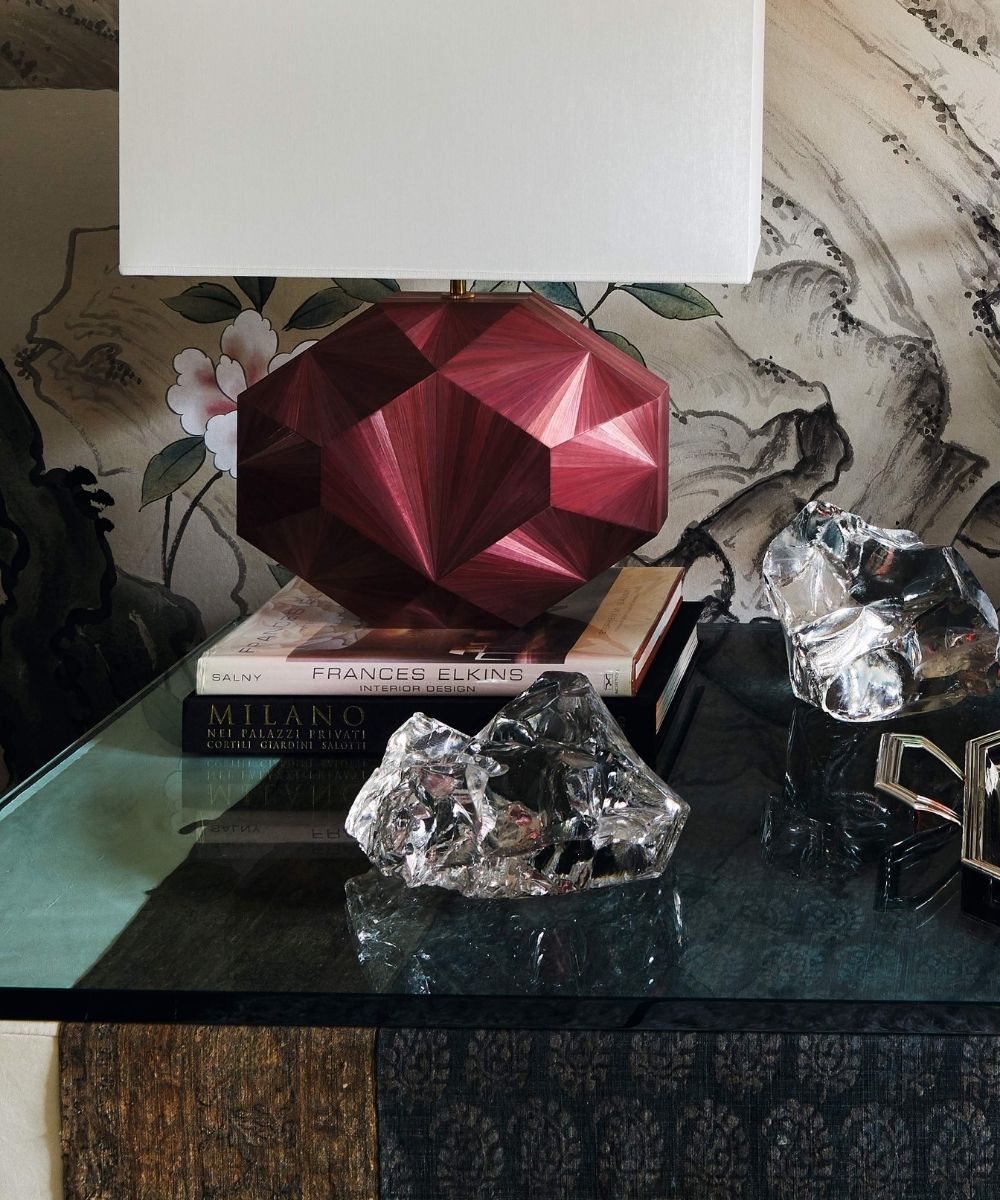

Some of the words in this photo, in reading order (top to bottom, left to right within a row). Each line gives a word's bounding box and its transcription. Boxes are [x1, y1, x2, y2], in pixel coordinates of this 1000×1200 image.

[211, 673, 262, 682] SALNY
[312, 668, 425, 681] FRANCES
[438, 668, 524, 681] ELKINS
[359, 685, 421, 693] INTERIOR
[426, 685, 476, 693] DESIGN
[208, 704, 366, 727] MILANO
[207, 729, 232, 739] NEI
[241, 729, 300, 739] PALAZZI
[309, 729, 367, 740] PRIVATI
[207, 740, 252, 750] CORTILI
[260, 740, 313, 750] GIARDINI
[321, 740, 367, 751] SALOTTI
